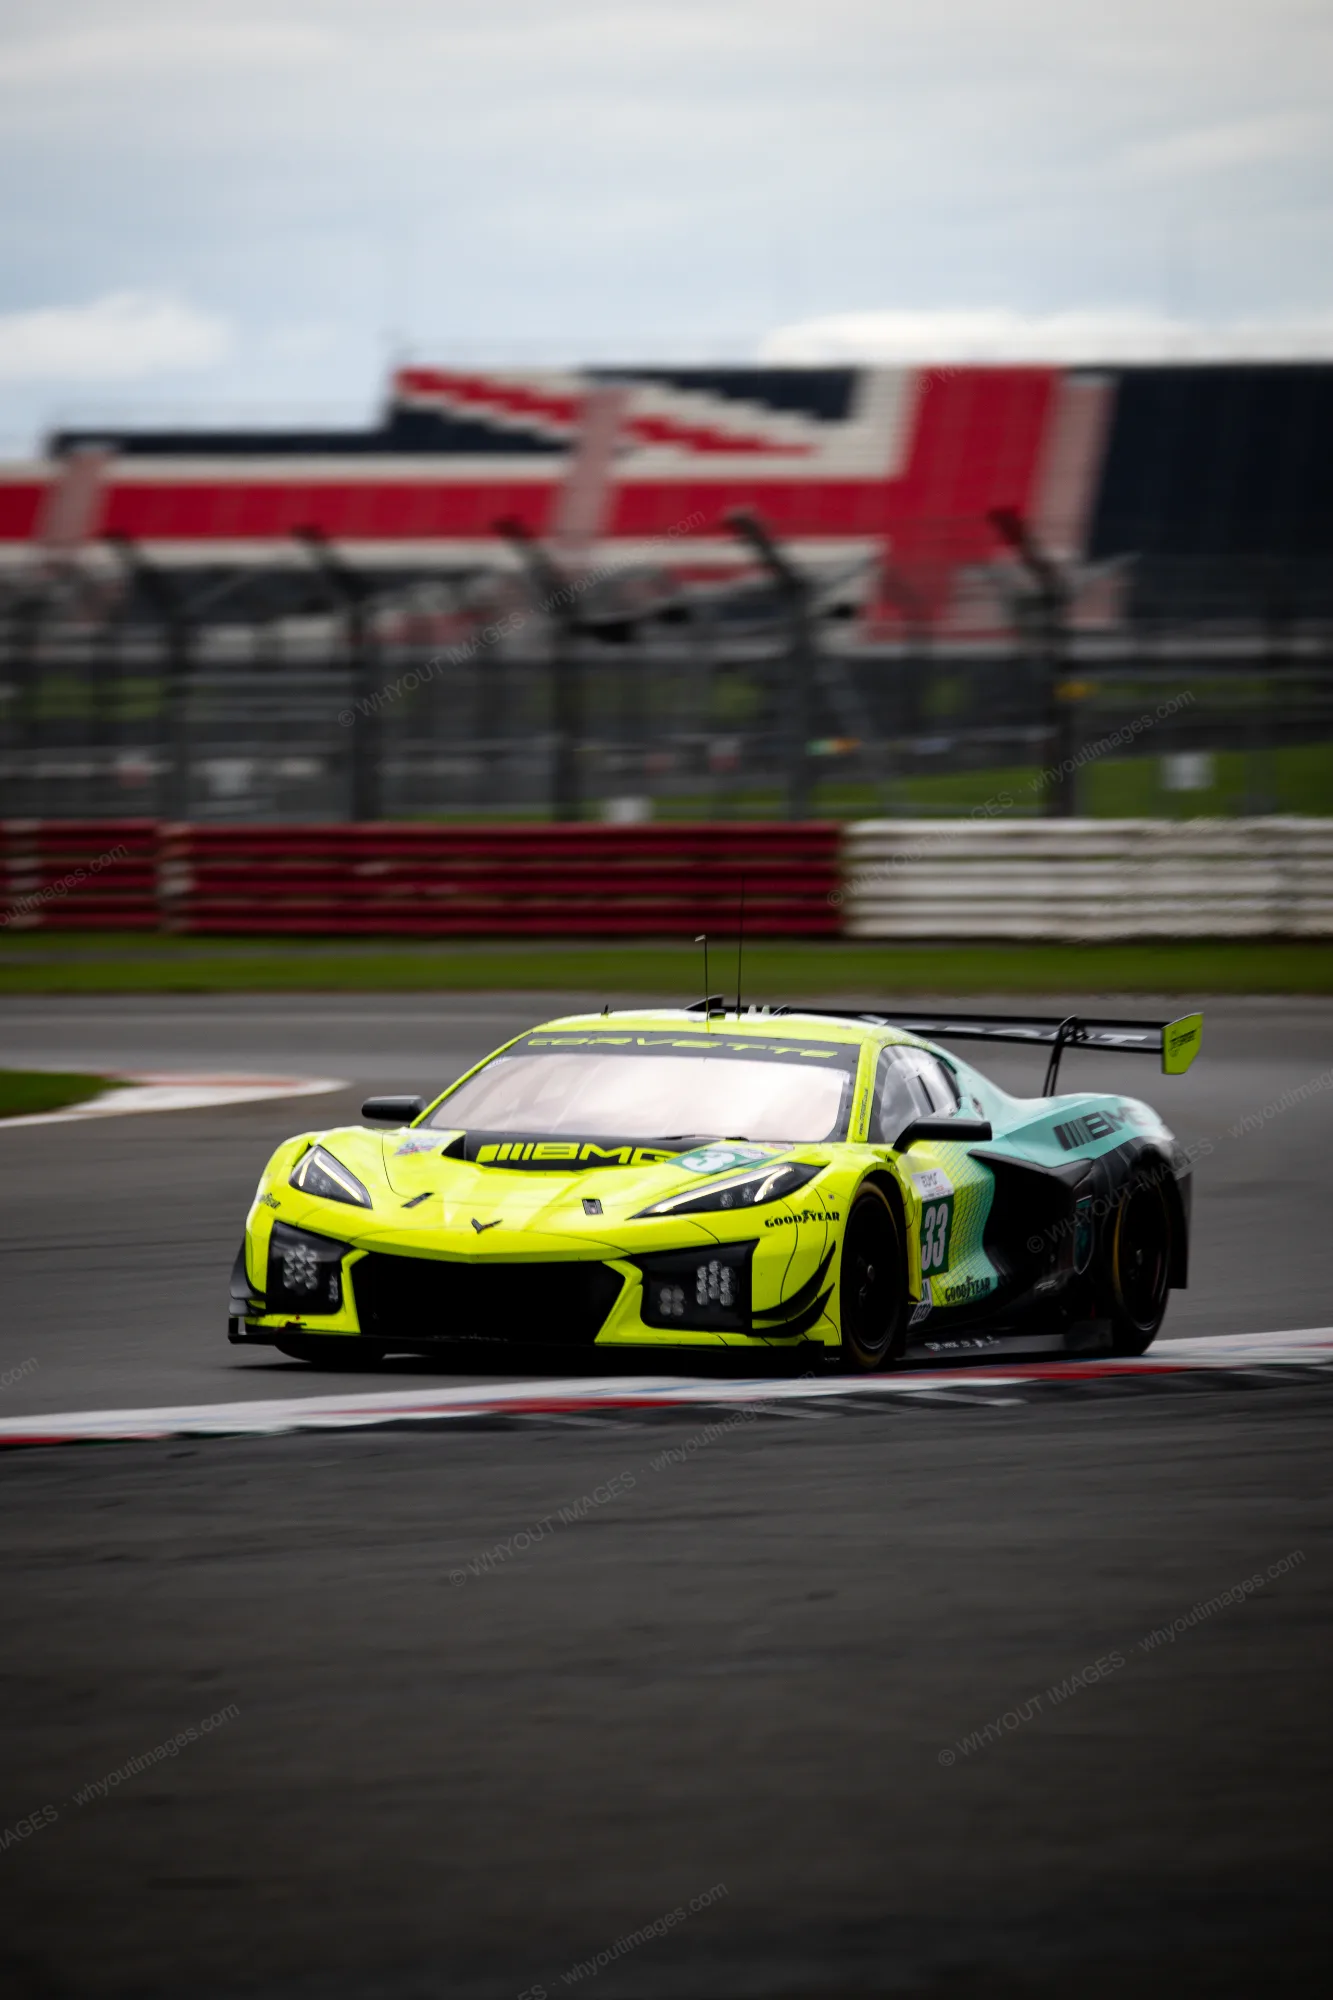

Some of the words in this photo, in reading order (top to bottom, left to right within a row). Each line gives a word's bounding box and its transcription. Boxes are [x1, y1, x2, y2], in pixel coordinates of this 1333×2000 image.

[527, 1036, 838, 1059] CORVETTE
[764, 1210, 840, 1228] GOODYEAR
[922, 1203, 949, 1271] 33
[944, 1276, 991, 1302] GOODYEAR
